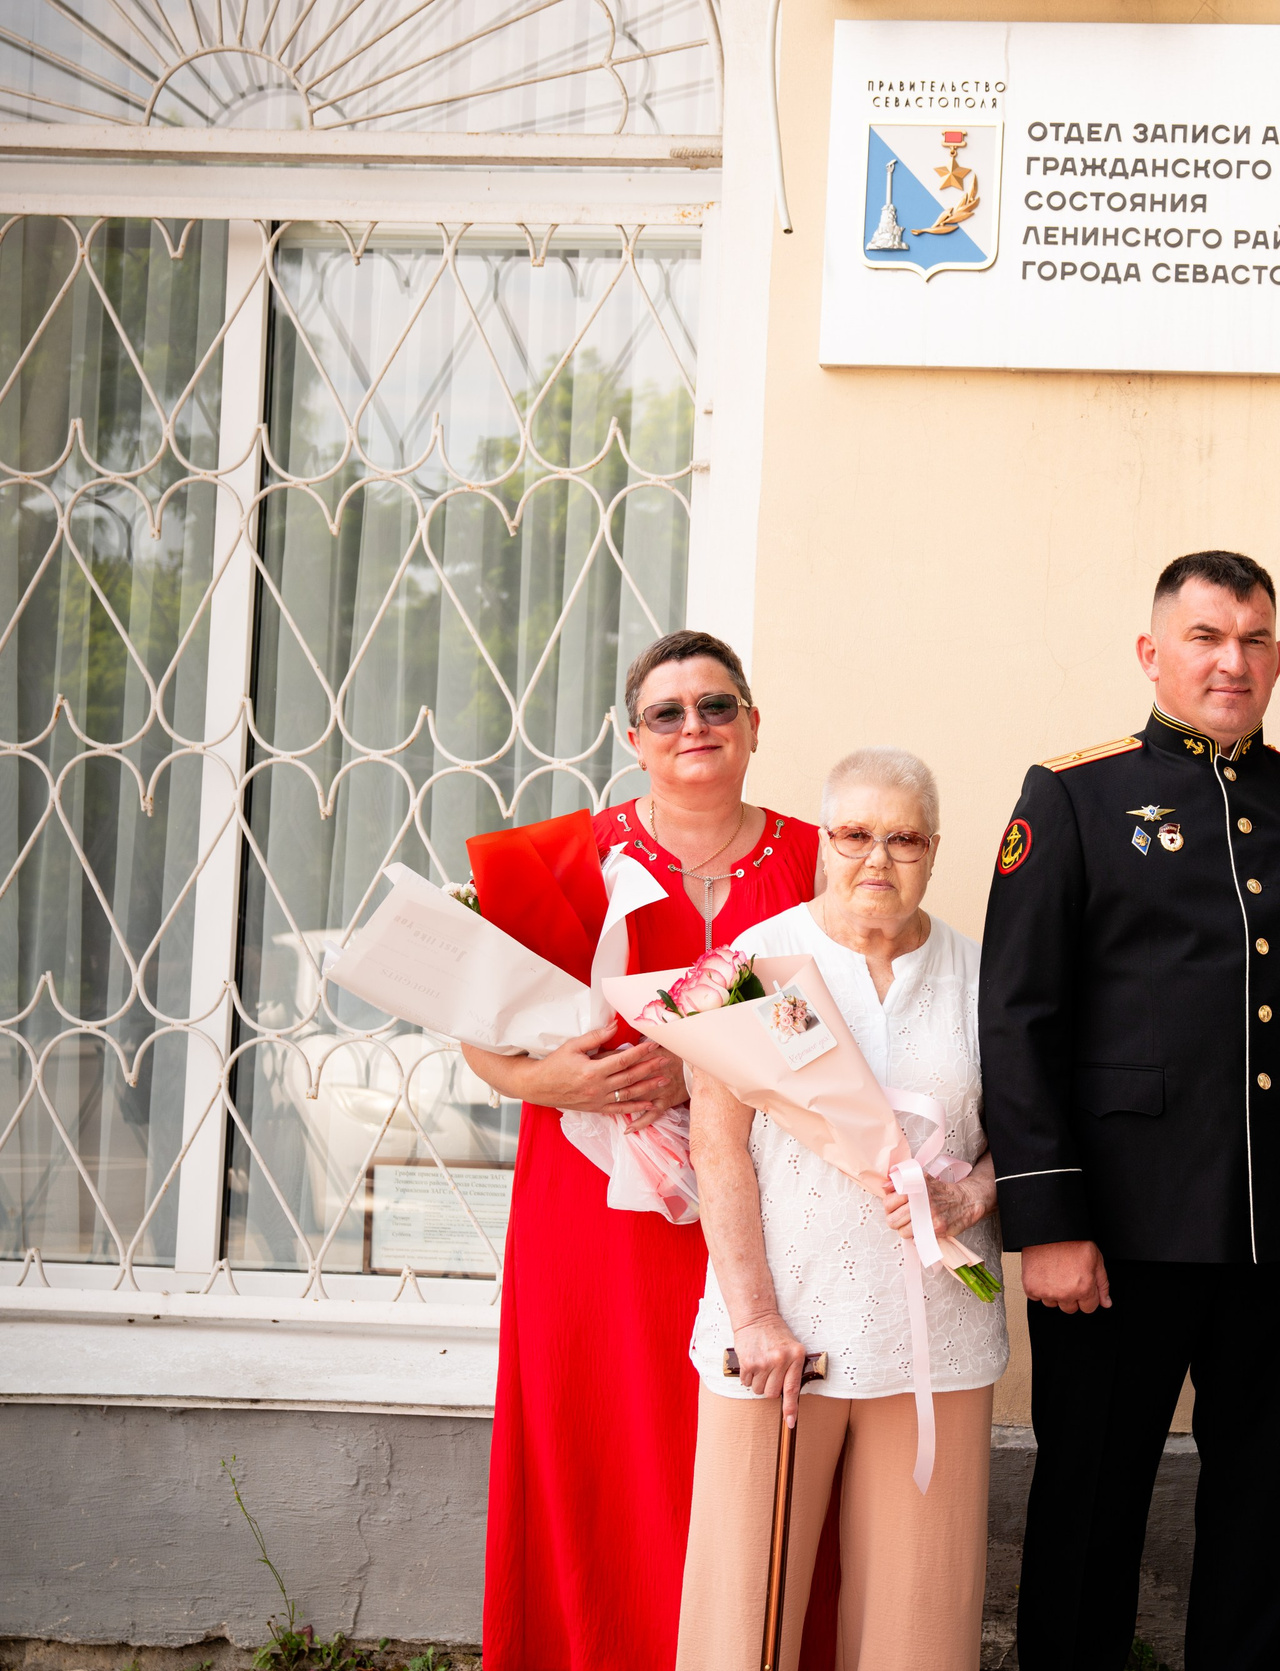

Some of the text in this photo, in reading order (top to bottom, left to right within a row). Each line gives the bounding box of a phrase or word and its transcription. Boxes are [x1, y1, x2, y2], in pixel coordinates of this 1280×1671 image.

[867, 79, 1007, 93] ПРАВИТЕЛЬСТВО
[872, 96, 998, 109] СЕВАСТОПОЛЯ
[1027, 121, 1123, 144] ОТДЕЛ
[1132, 122, 1251, 145] ЗАПИСИ
[1025, 156, 1273, 181] ГРАЖДАНСКОГО
[1023, 190, 1208, 213] СОСТОЯНИЯ
[1022, 226, 1223, 250] ЛЕНИНСКОГО
[1021, 259, 1141, 285] ГОРОДА
